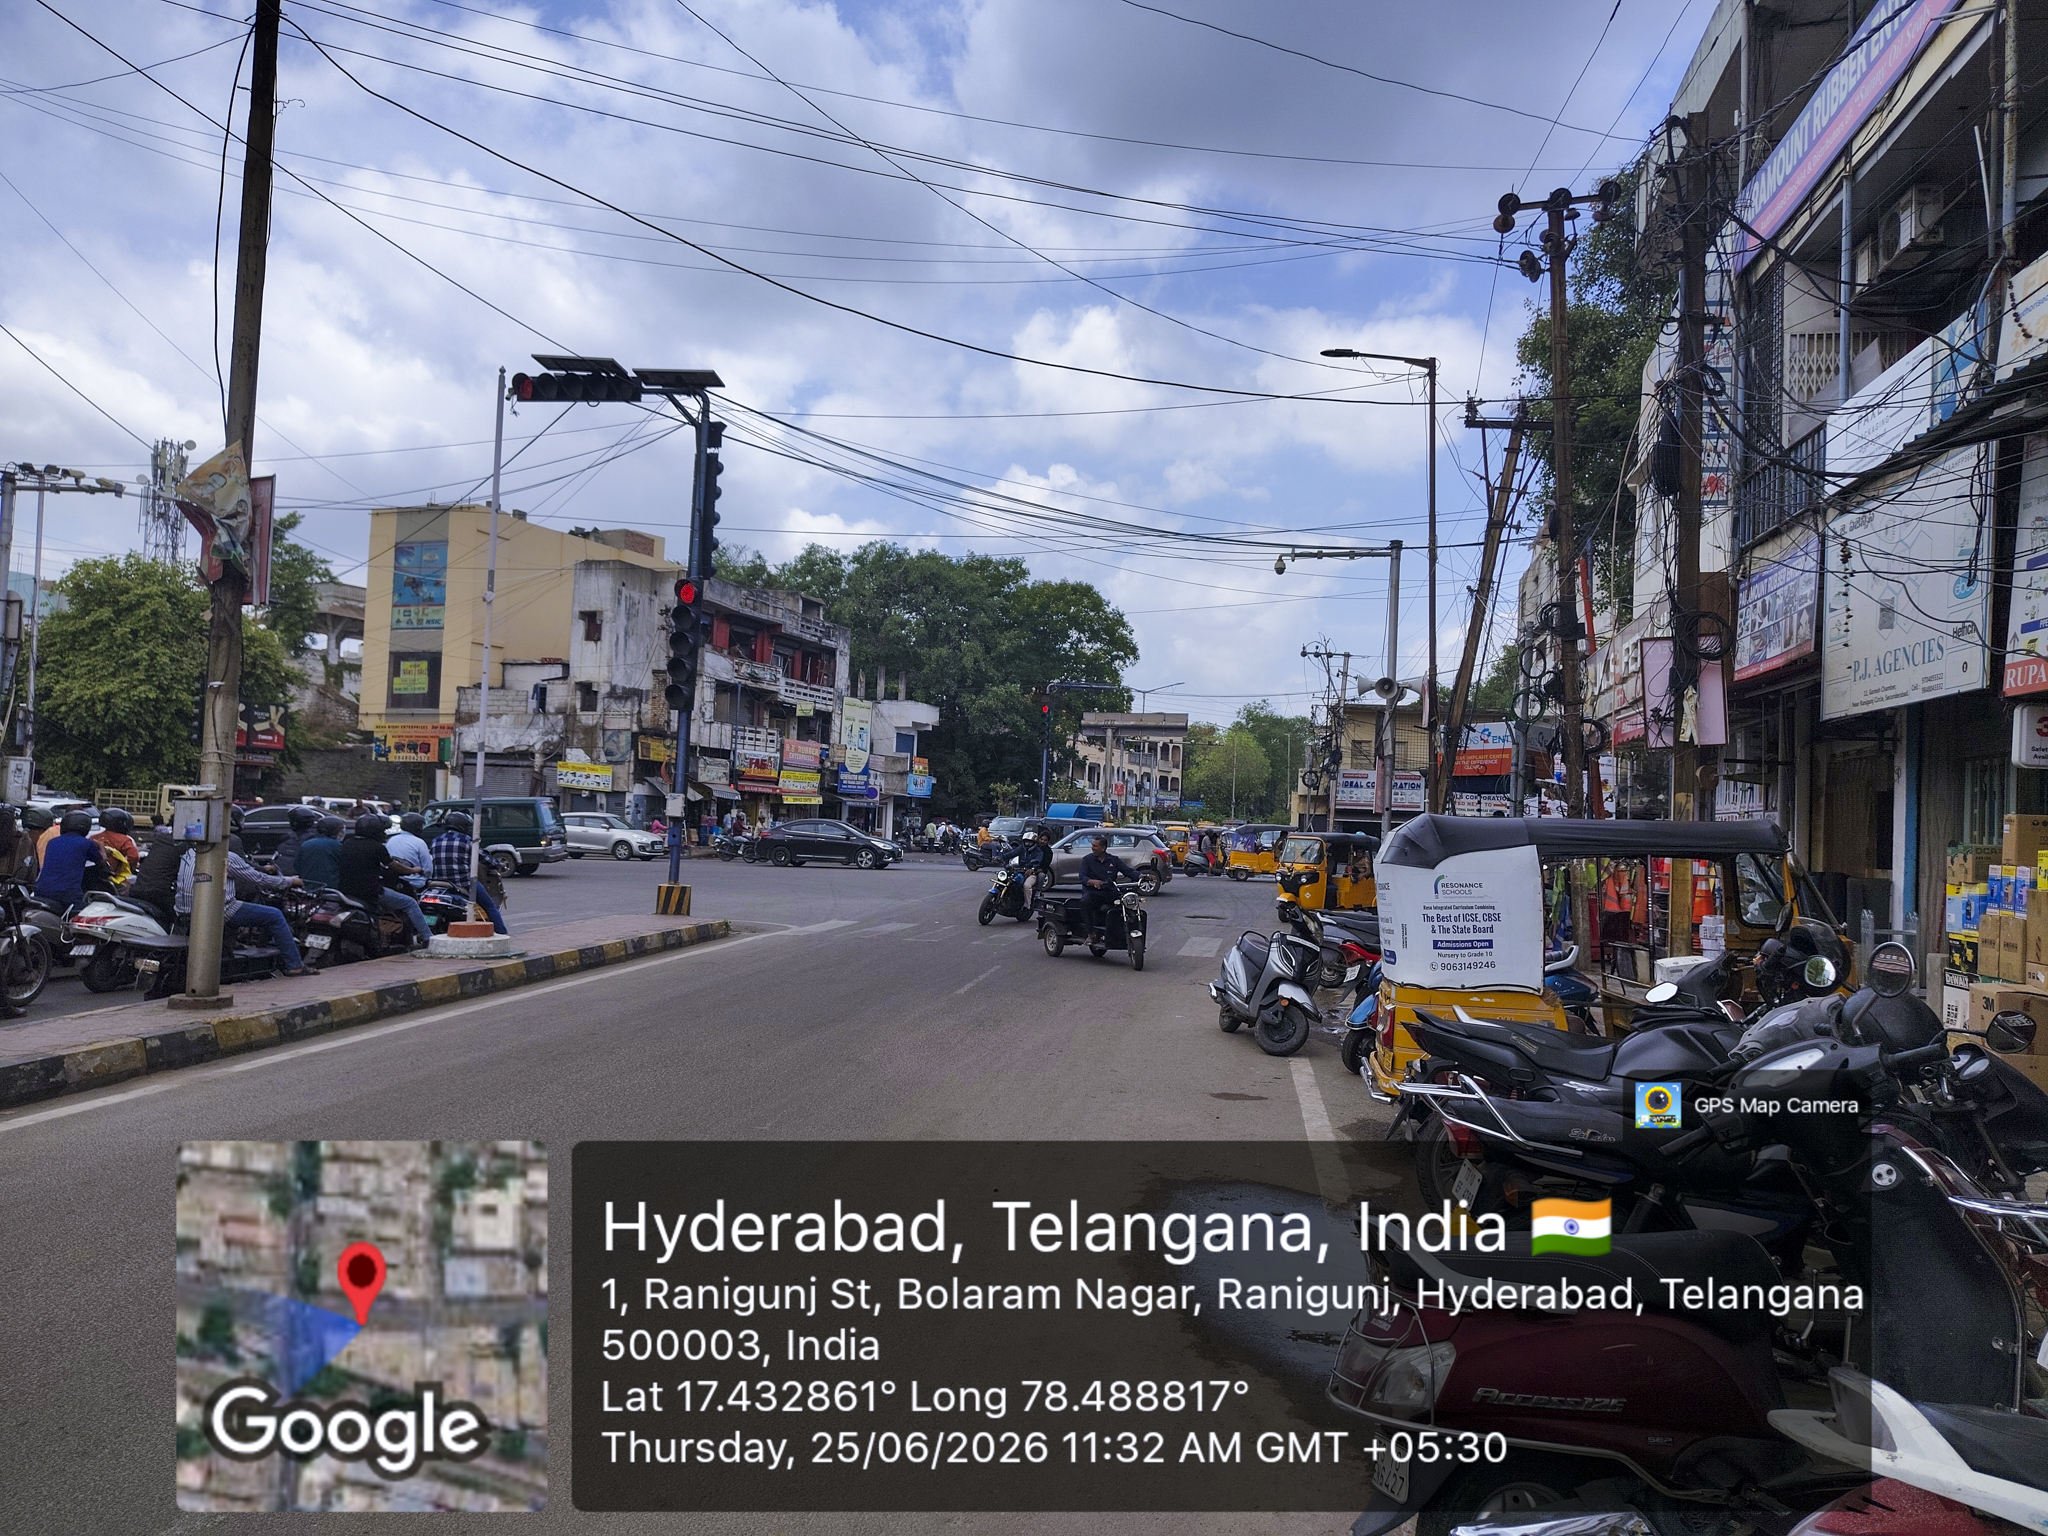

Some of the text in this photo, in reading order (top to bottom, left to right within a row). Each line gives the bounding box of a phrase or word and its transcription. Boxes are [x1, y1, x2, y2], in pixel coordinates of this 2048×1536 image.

[1812, 33, 1867, 141] RUBBER
[1812, 118, 1845, 167] Distributors
[1873, 635, 1945, 678] AGENCIES
[2005, 663, 2047, 690] RUPA
[1422, 912, 1502, 923] The Best of ICSE, CBSE
[1431, 924, 1494, 934] & The State Board
[1441, 961, 1496, 971] 9063149246
[1982, 996, 1995, 1012] 3M
